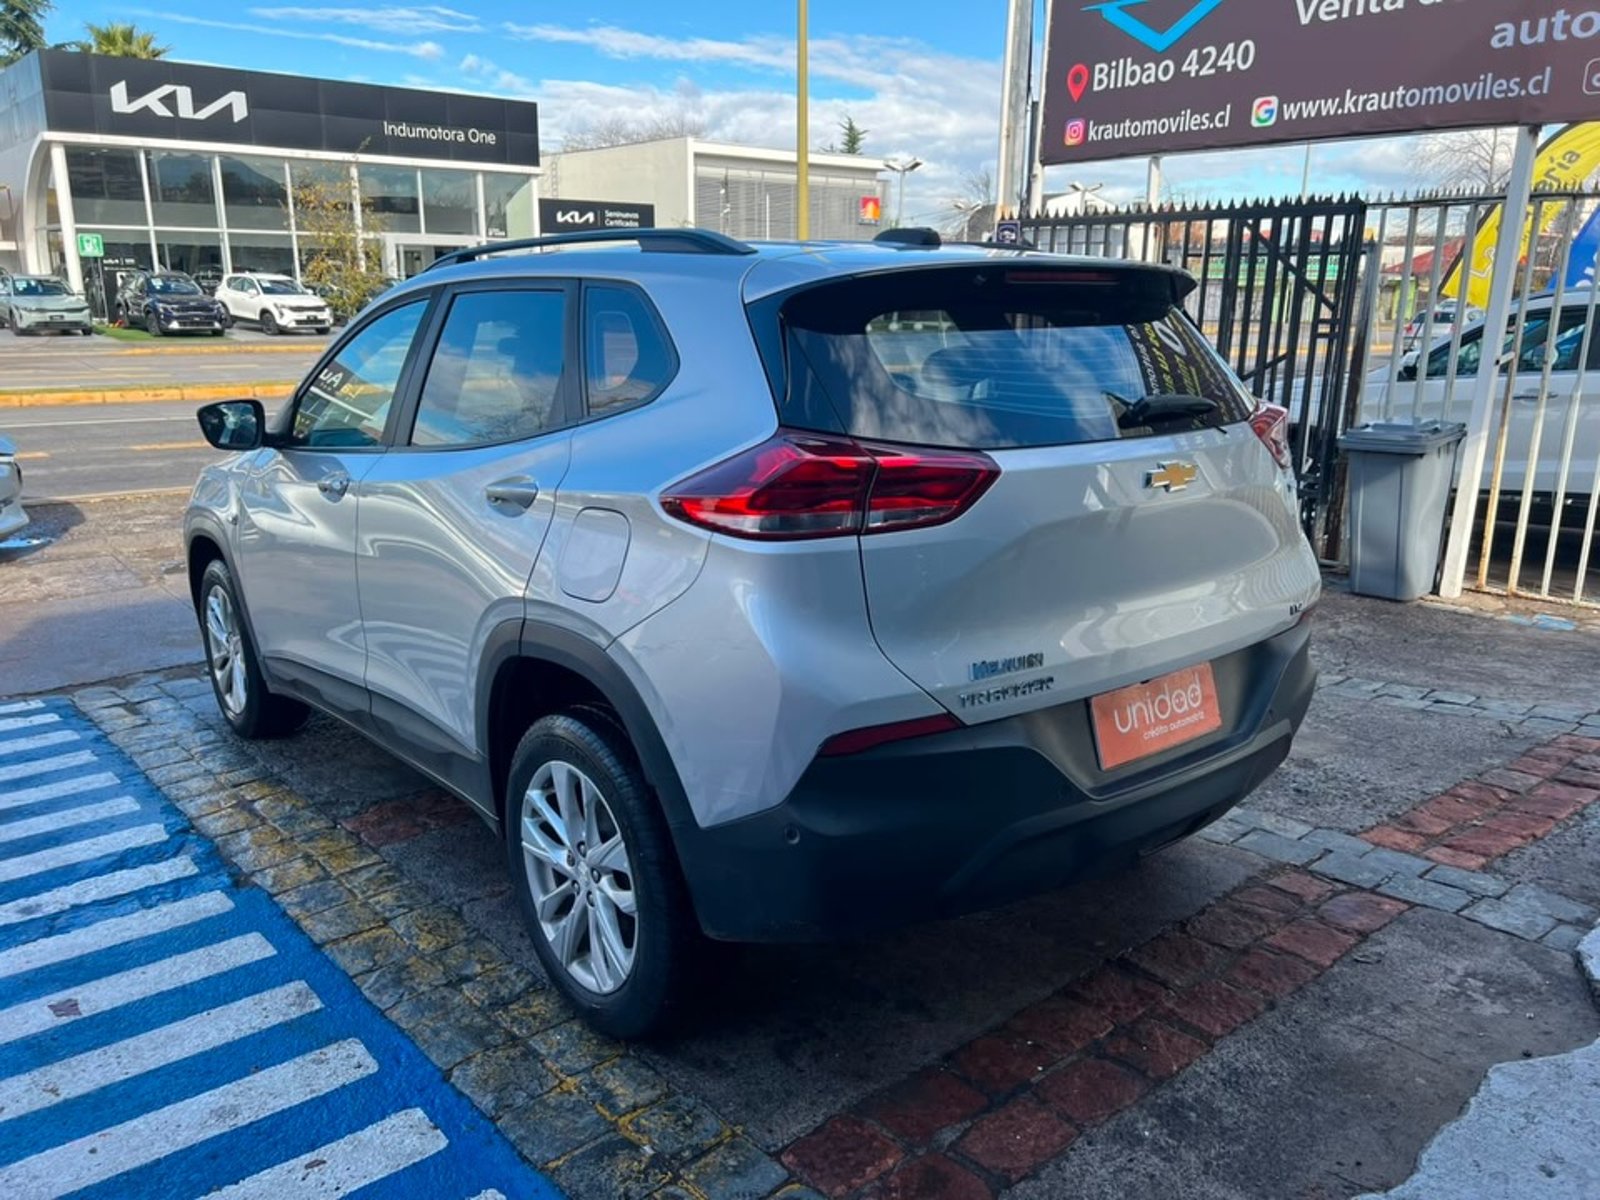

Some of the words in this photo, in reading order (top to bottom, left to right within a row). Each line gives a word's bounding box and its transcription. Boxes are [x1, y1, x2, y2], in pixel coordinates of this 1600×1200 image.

[1490, 9, 1600, 49] auto
[1092, 57, 1175, 91] Bilbao
[1181, 39, 1256, 77] 4240
[110, 80, 248, 123] KIA
[1282, 66, 1552, 121] www.krautomoviles.cl
[383, 121, 465, 142] Indumotora
[467, 128, 497, 145] One
[1087, 104, 1231, 142] krautomoviles.cl
[556, 210, 595, 224] KIA
[1114, 672, 1202, 733] unidad
